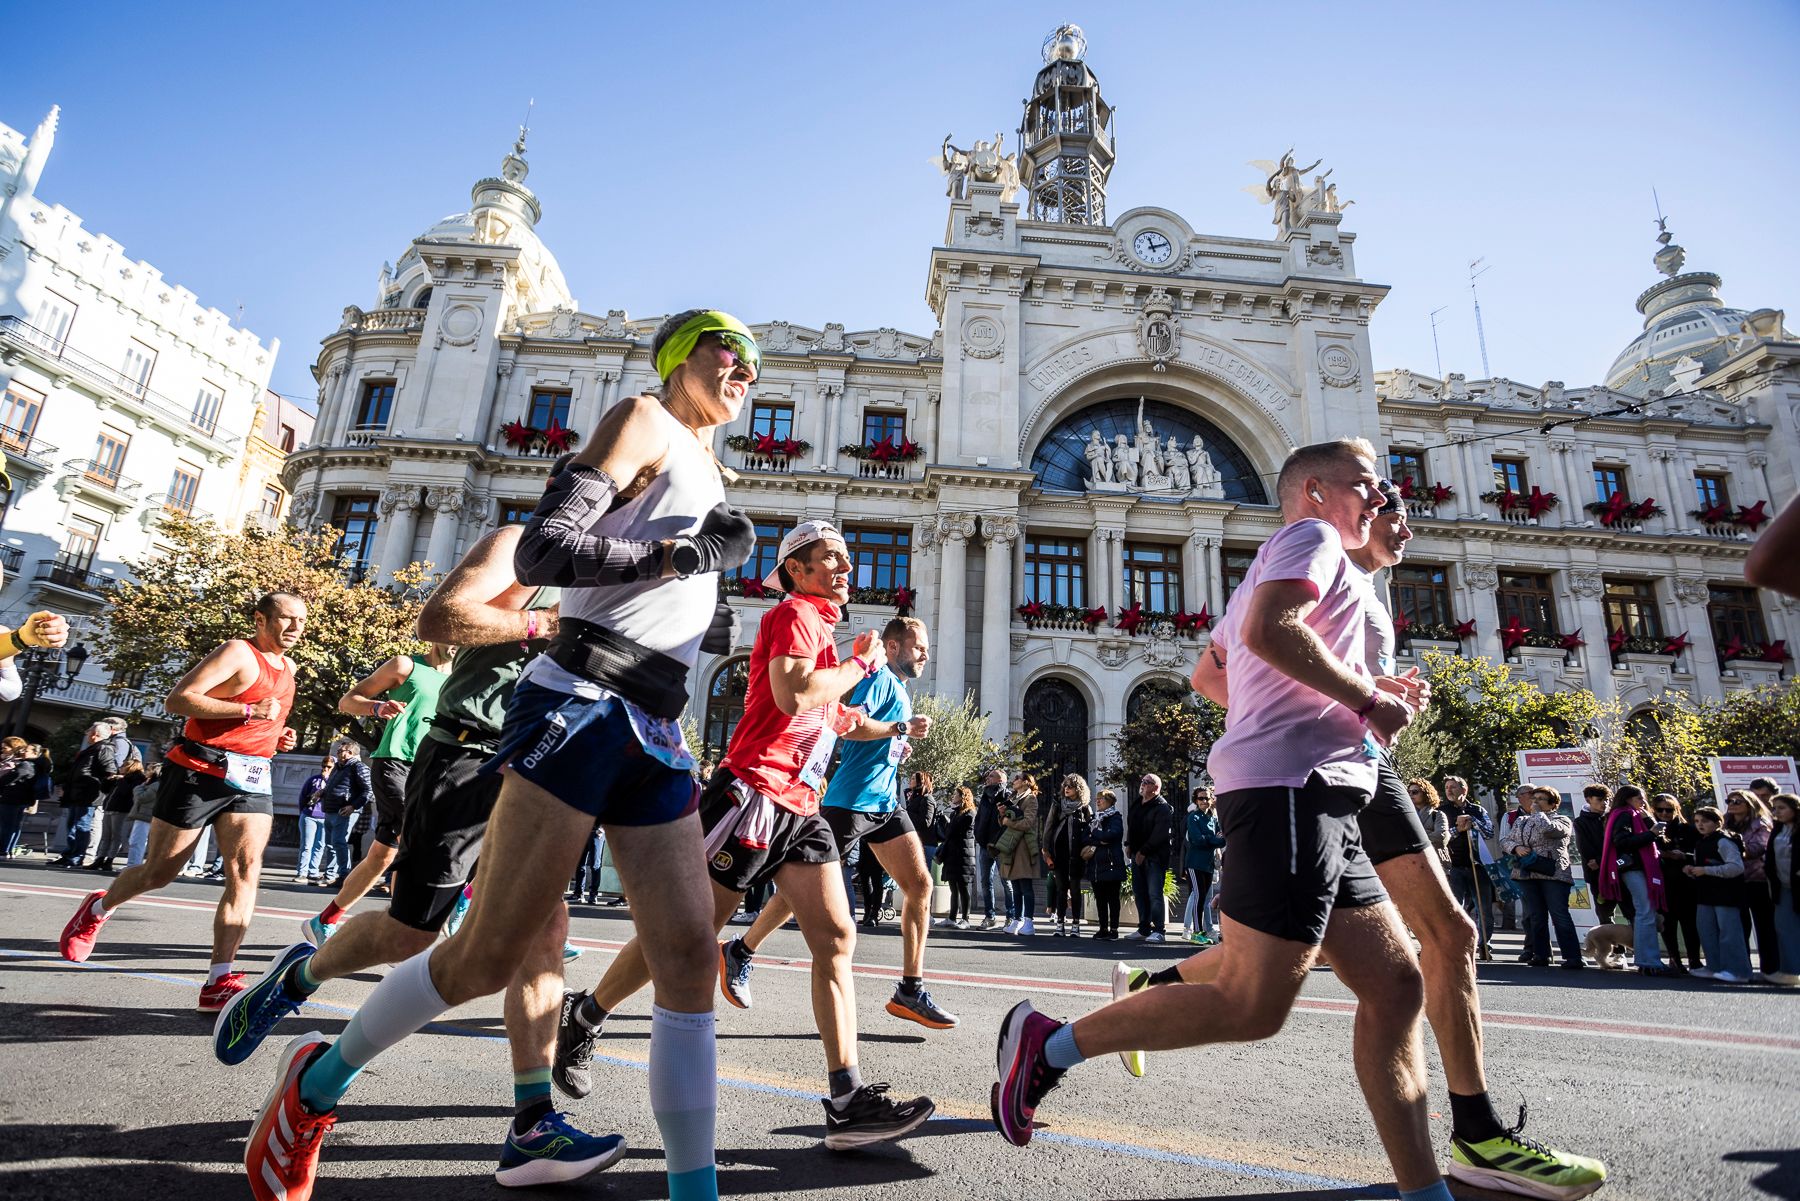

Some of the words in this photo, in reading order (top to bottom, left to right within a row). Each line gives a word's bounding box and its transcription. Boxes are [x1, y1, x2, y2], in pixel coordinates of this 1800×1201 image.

[971, 324, 995, 338] AÑO
[1028, 346, 1093, 391] CORREOS
[1199, 345, 1291, 411] TELEGRAFOS
[523, 711, 567, 769] ADIZERO
[561, 995, 575, 1027] HOKA
